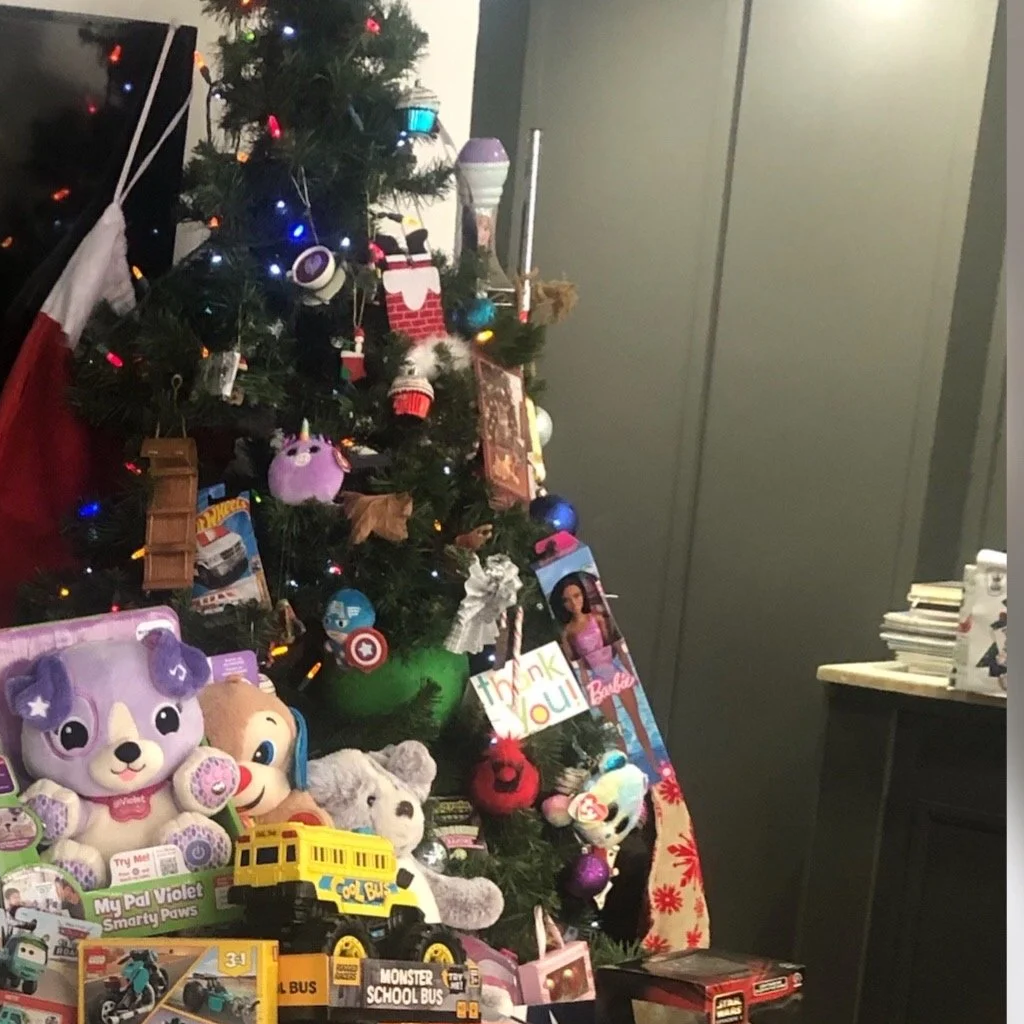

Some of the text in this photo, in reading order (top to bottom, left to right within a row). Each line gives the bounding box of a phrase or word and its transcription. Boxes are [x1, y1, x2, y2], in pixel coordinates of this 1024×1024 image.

[587, 672, 636, 706] Barbie
[94, 883, 204, 917] My Pal Violet
[364, 881, 390, 901] BUS
[103, 905, 198, 932] Smarty Paws
[289, 981, 317, 994] BUS
[380, 968, 434, 986] MONSTER
[366, 985, 444, 1006] SCHOOL BUS
